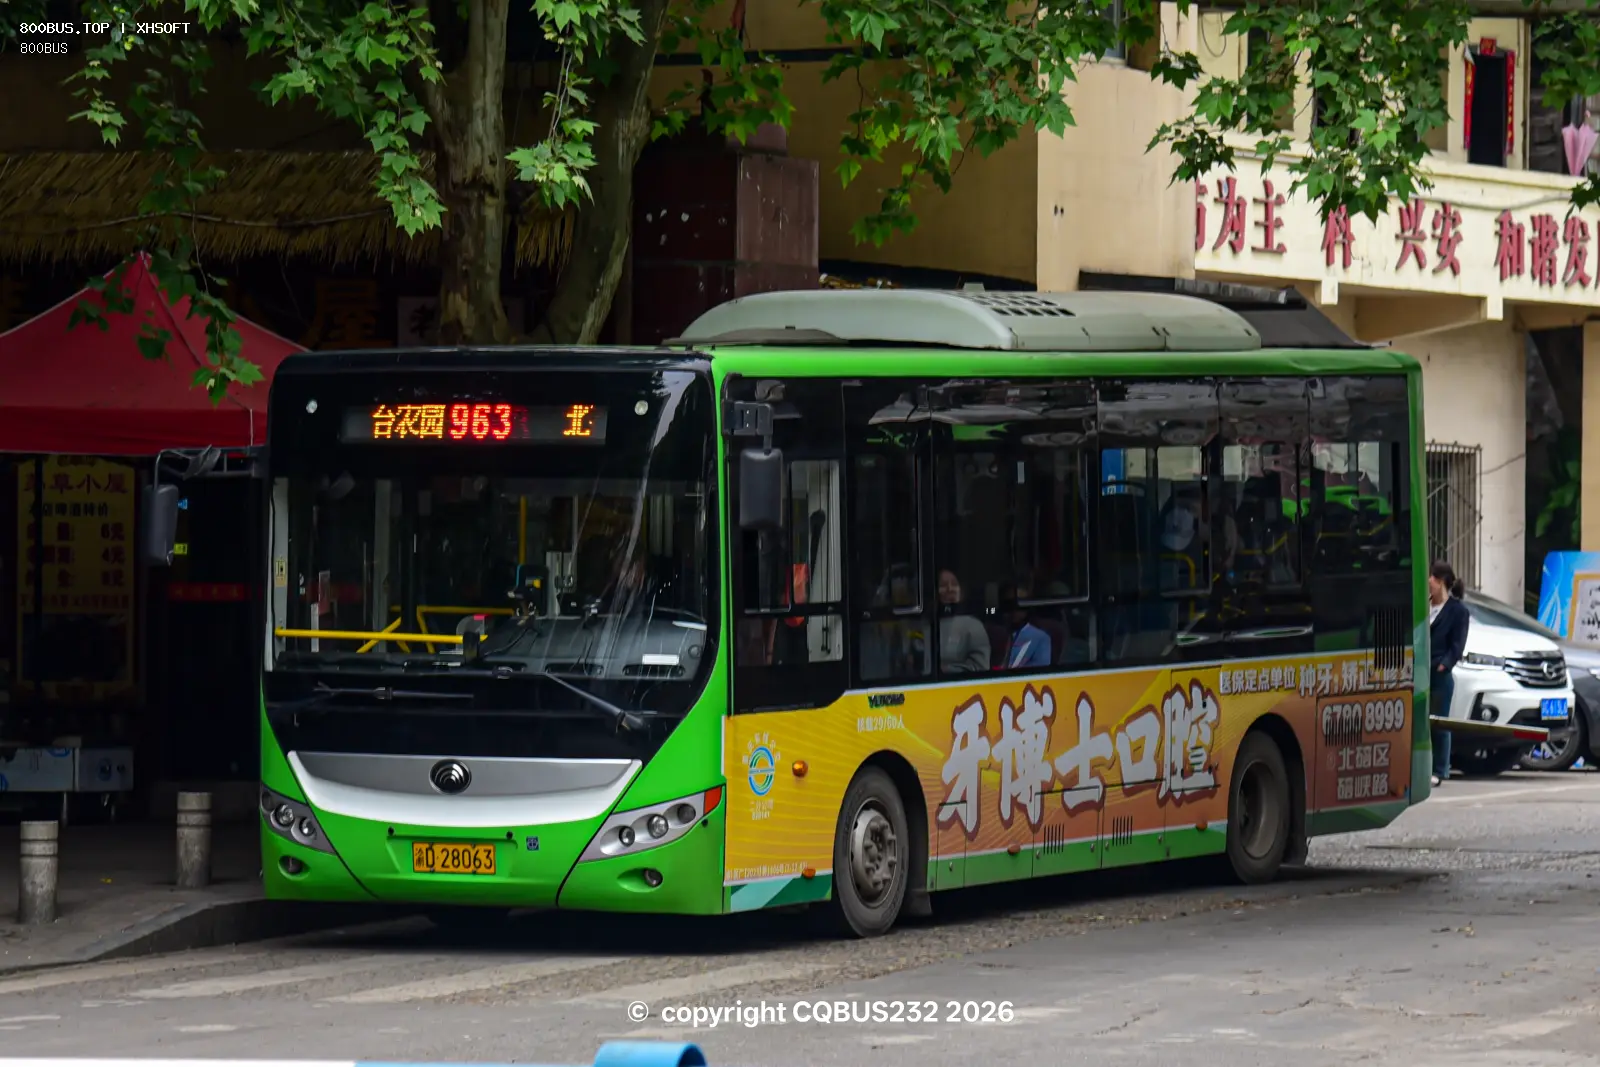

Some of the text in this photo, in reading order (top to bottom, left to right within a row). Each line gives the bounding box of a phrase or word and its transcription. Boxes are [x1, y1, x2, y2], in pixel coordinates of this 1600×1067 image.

[1395, 199, 1464, 276] 兴安
[1494, 208, 1600, 291] 和谐发
[371, 404, 447, 439] 台农园
[449, 403, 512, 440] 963
[1219, 666, 1296, 695] 医保定点单位
[1364, 698, 1407, 732] 8999
[937, 681, 1220, 837] 牙博士口腔
[1338, 742, 1390, 772] 北碚区
[1337, 774, 1389, 801] 碚峡路
